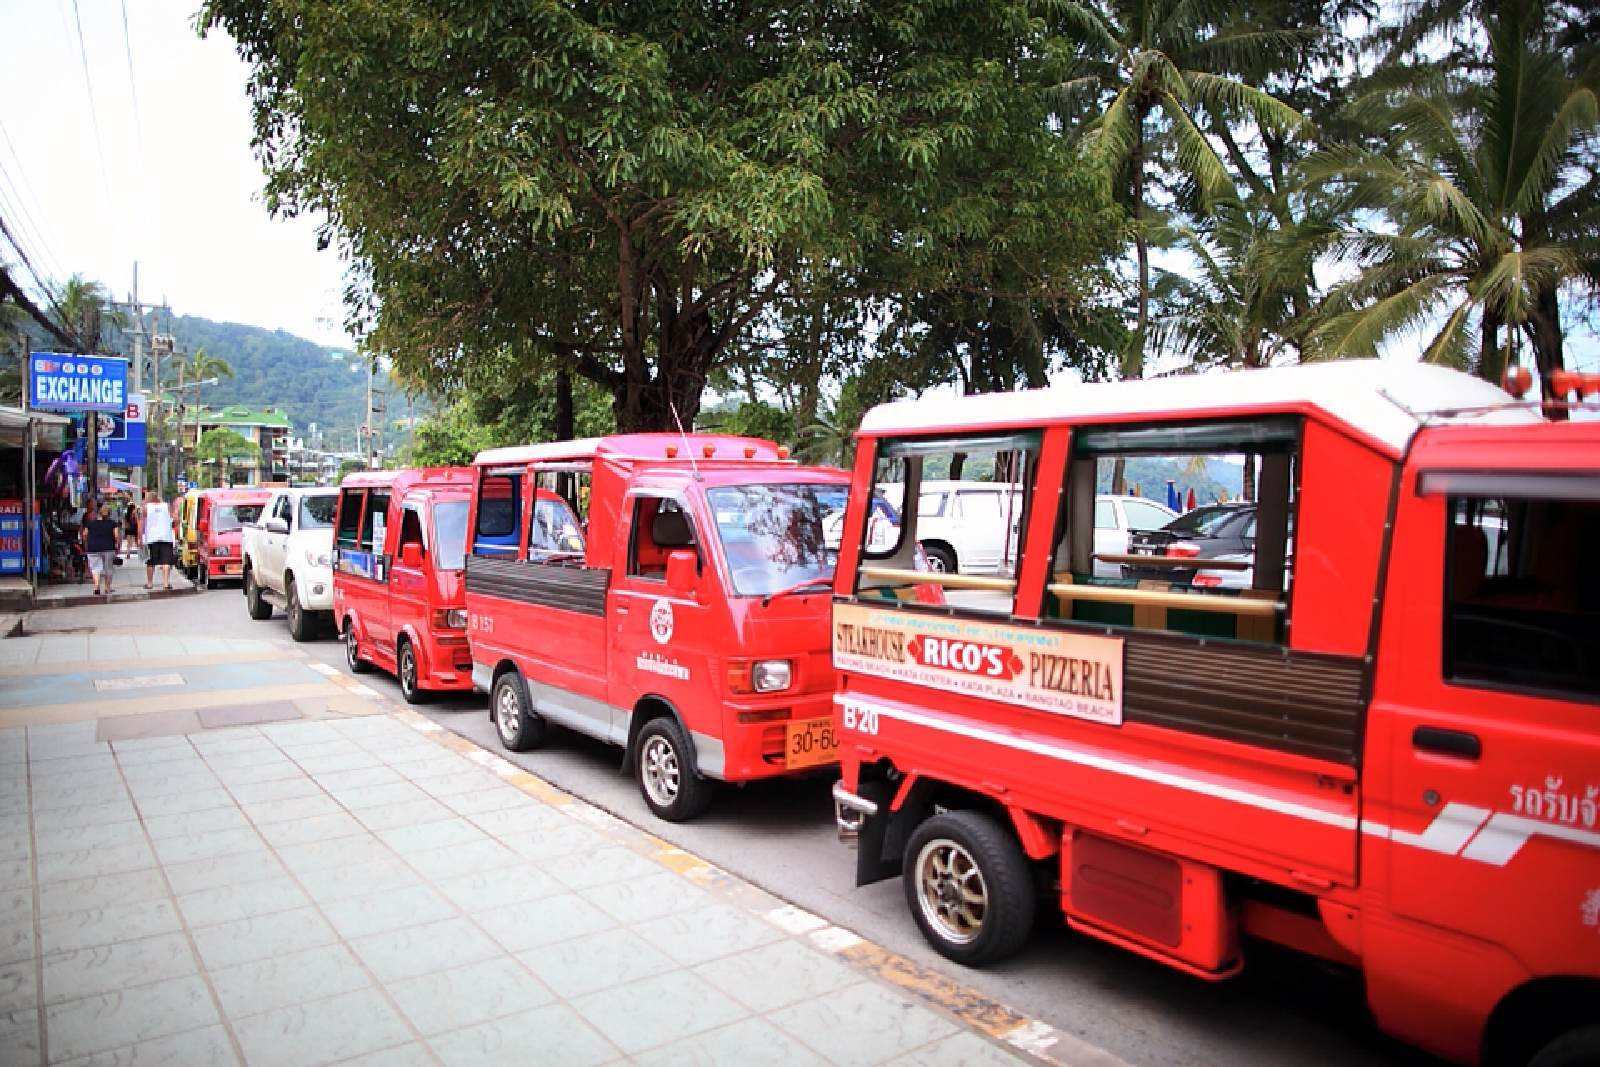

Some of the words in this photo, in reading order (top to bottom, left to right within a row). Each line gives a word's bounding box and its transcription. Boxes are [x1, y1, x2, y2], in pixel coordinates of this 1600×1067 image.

[36, 376, 123, 403] EXCHANGE
[836, 623, 905, 663] STEAKHOUSE
[924, 638, 1003, 676] RICO'S
[1030, 651, 1114, 703] PIZZERIA
[1510, 774, 1600, 826] รถรับจ้
